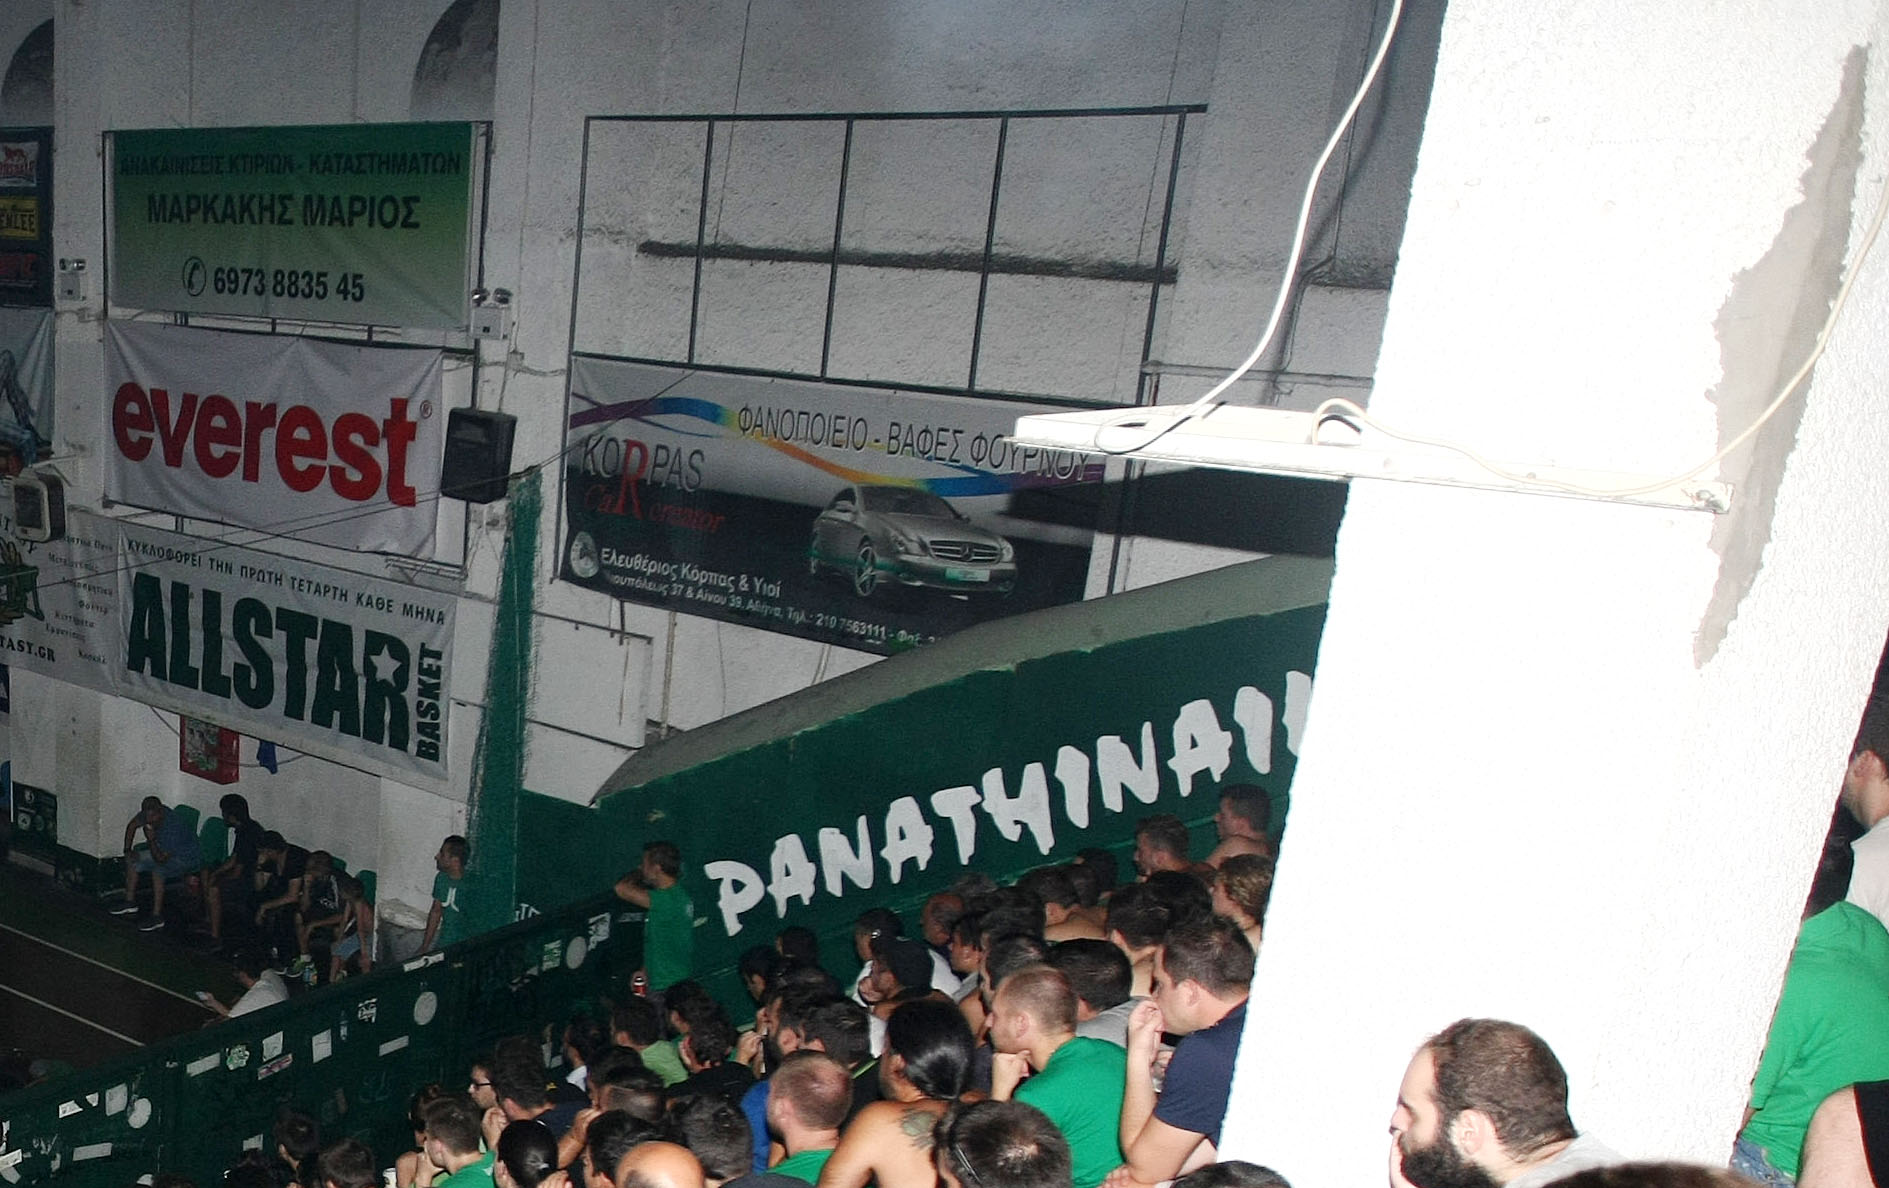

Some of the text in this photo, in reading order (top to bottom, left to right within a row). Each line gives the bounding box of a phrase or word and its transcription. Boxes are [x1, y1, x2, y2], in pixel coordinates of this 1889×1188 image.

[308, 152, 461, 175] ΚΑΤΑΣΤΗΜΑΤΩΝ
[147, 194, 421, 229] ΜΑΡΚΑΚΗΣ ΜΑΡΙΟΣ
[213, 268, 365, 302] 6973 8835 45
[112, 382, 417, 507] everest
[738, 403, 867, 451] ΦΑΝΟΠΟΙΕΙΟ
[888, 422, 964, 464] ΒΑΦΕΣ
[581, 434, 705, 494] KORPAS
[127, 539, 446, 625] ΚΥΚΛΟΦΟΡΕΙ ΤΗΝ ΠΡΩΤΗ ΤΕΤΑΡΤΗ ΚΑΘΕ ΜΗΝΑ
[600, 547, 782, 597] Ελευθέριος Κόρπας & Υιοί
[815, 613, 837, 629] 210
[127, 571, 411, 753] ALLSTAR
[415, 642, 443, 762] BASKET
